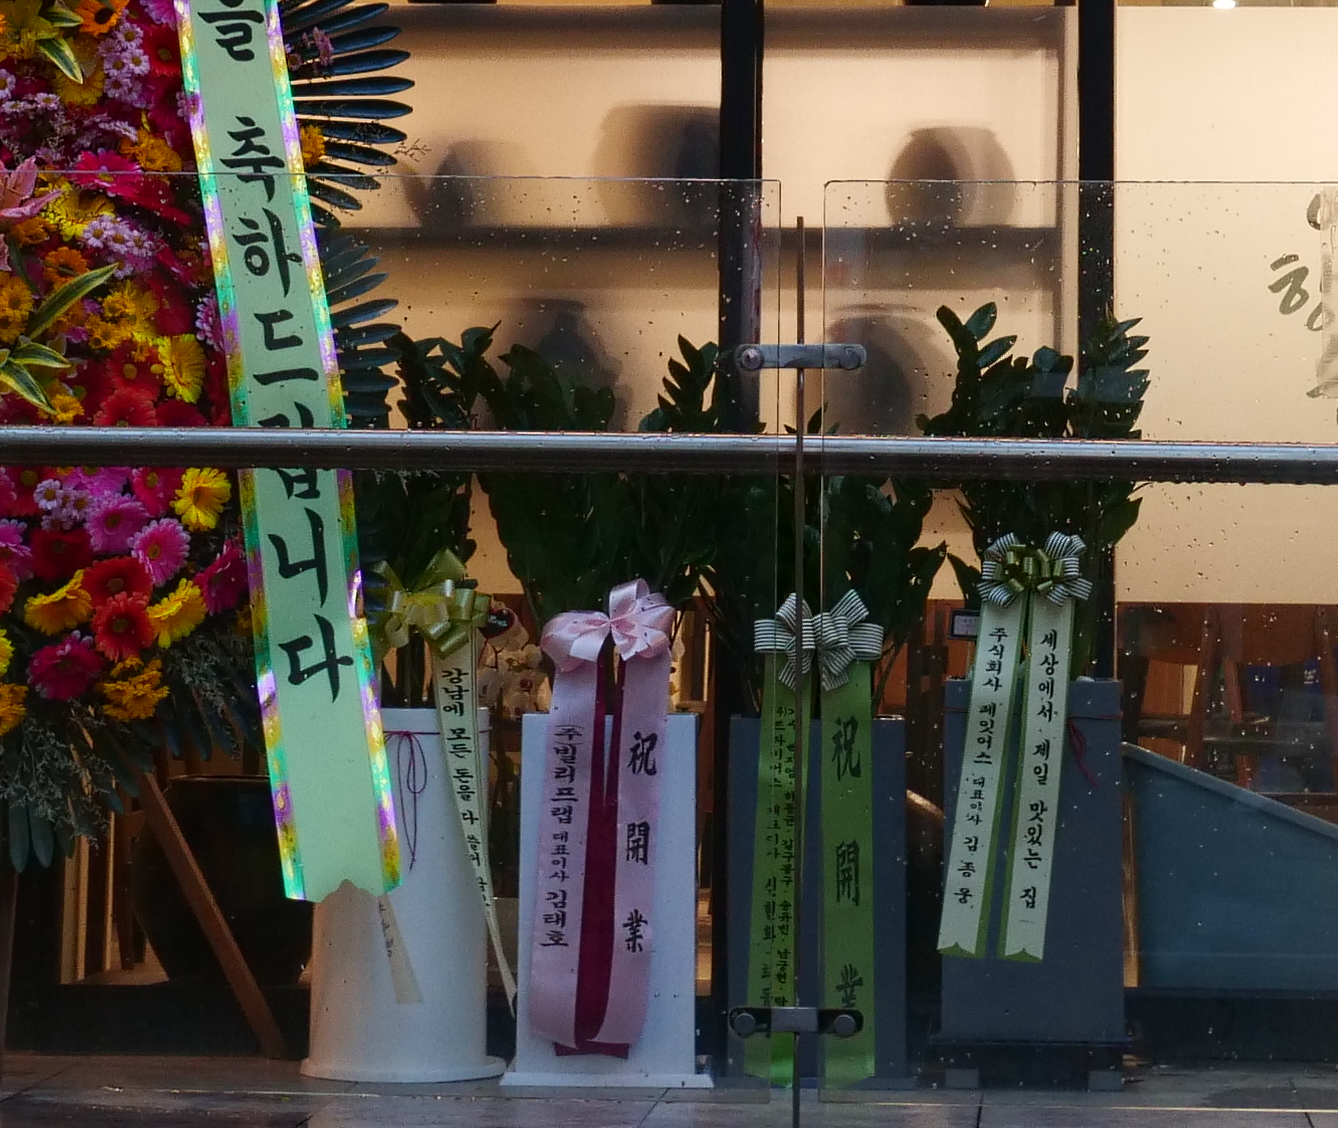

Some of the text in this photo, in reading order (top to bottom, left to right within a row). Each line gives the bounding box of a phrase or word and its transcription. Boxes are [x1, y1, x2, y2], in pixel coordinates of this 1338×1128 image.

[982, 627, 1008, 692] 주식회사
[1019, 628, 1059, 909] 세상에서 제일 맛있는 집
[461, 809, 480, 825] 다
[965, 776, 986, 826] 대표이사
[548, 830, 570, 883] 대표이사
[540, 889, 569, 948] 김태호
